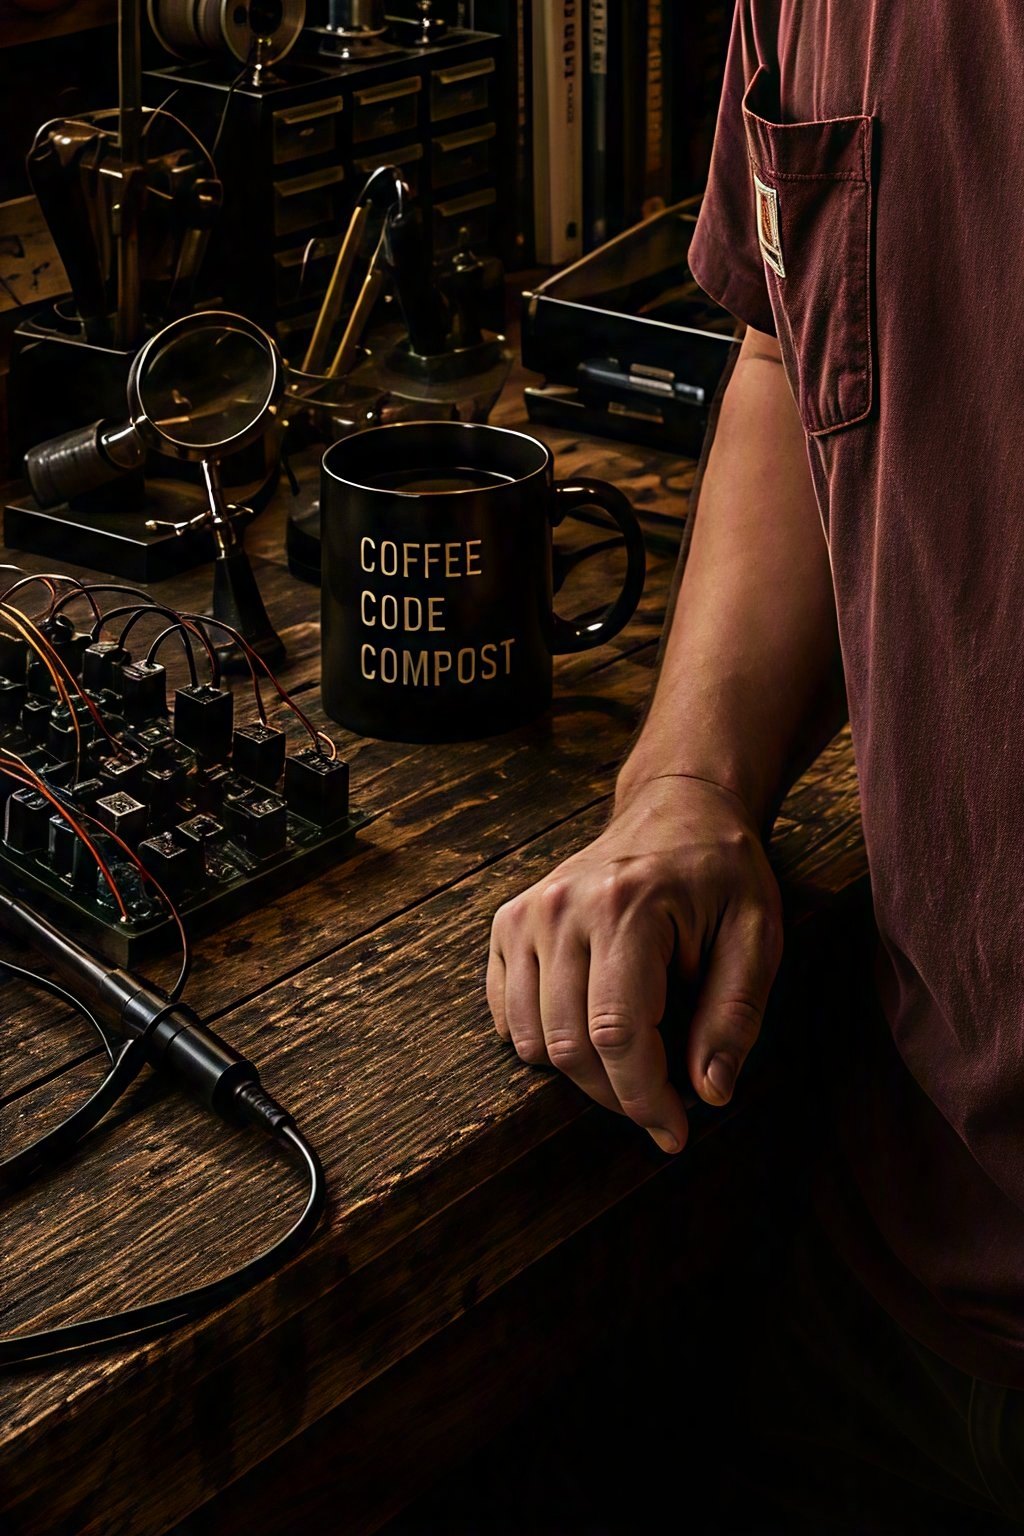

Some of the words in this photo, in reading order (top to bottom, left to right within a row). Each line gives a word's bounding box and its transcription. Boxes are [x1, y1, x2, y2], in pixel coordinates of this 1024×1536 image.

[360, 536, 482, 579] COFFEE
[360, 590, 446, 632] CODE
[360, 638, 515, 687] COMPOST
